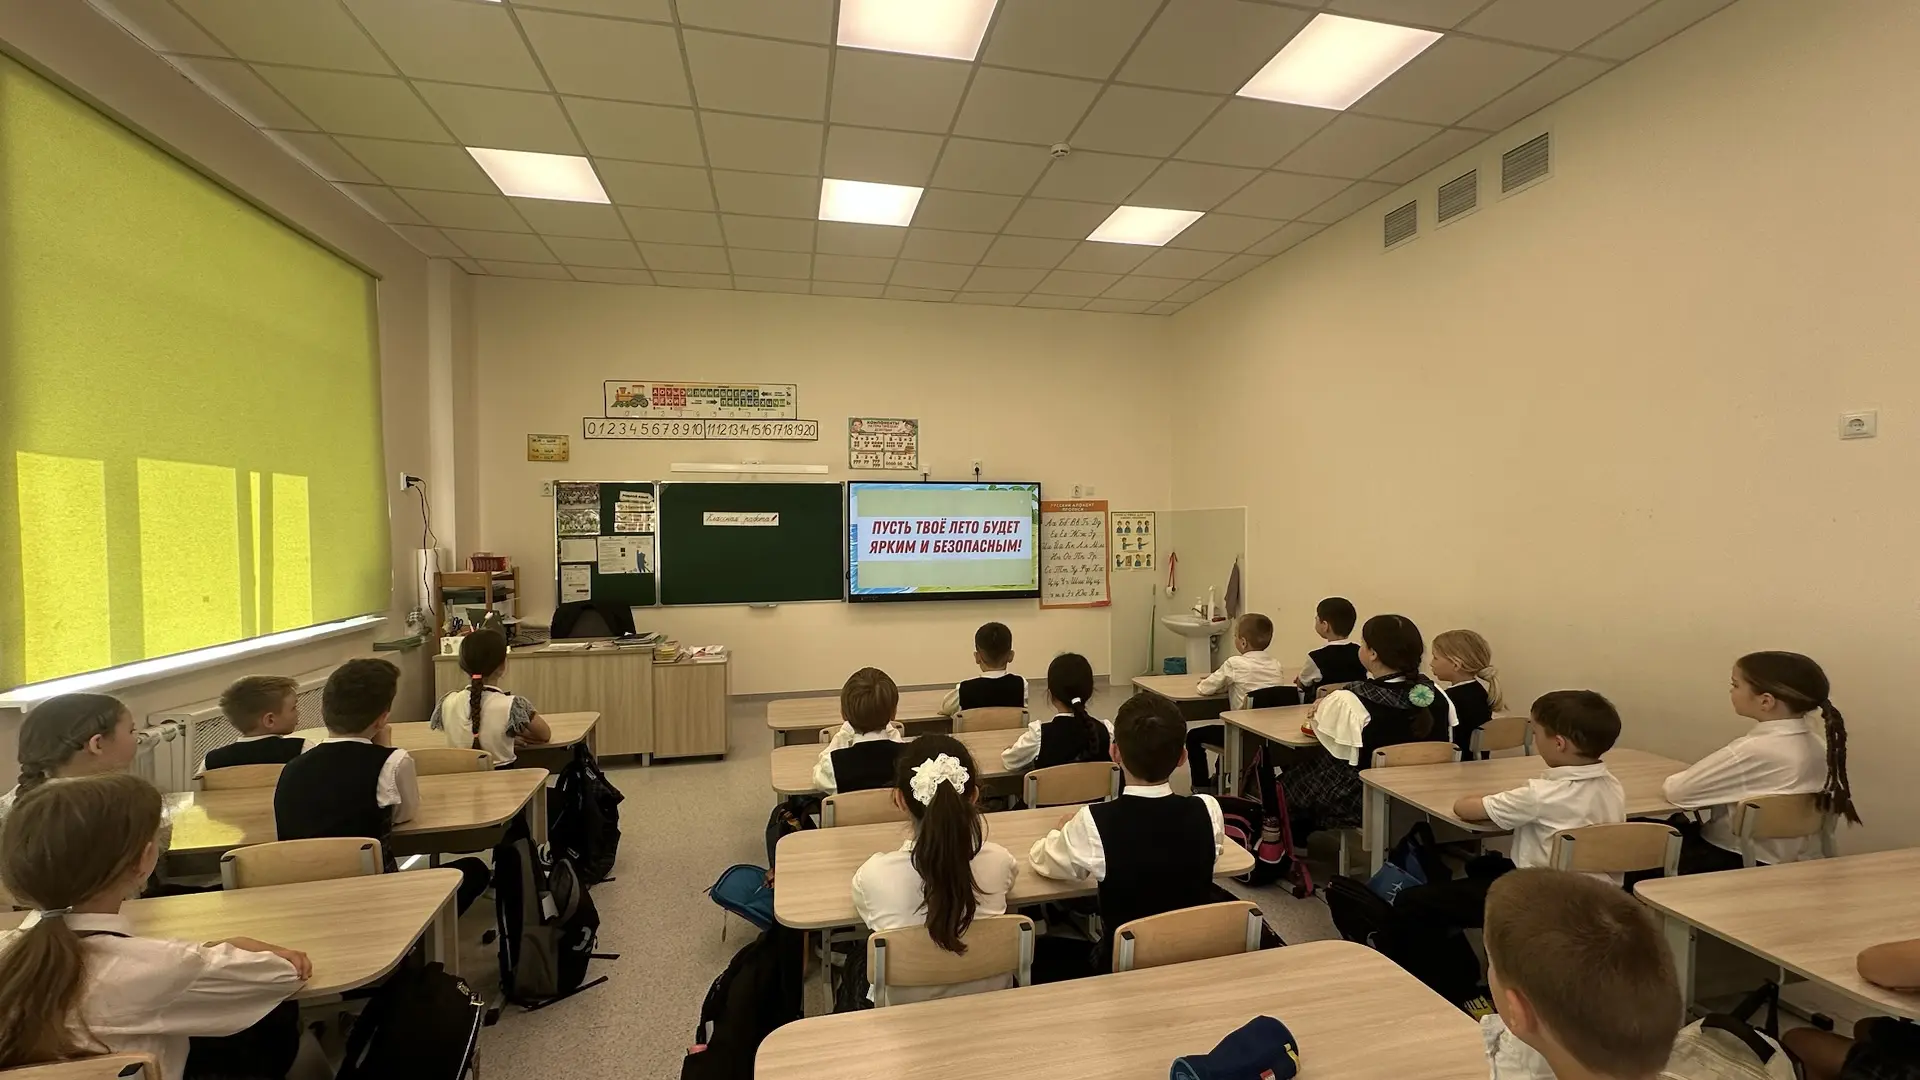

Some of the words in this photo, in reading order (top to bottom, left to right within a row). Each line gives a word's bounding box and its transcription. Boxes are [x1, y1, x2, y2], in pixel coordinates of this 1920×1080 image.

[872, 520, 912, 534] ПУСТЬ
[916, 518, 947, 534] ТВОЁ
[949, 520, 979, 534] ЛЕТО
[983, 520, 1020, 535] БУДЕТ
[869, 540, 916, 554] ЯРКИМ
[920, 540, 930, 553] И
[933, 539, 1022, 553] БЕЗОПАСНЫМ!
